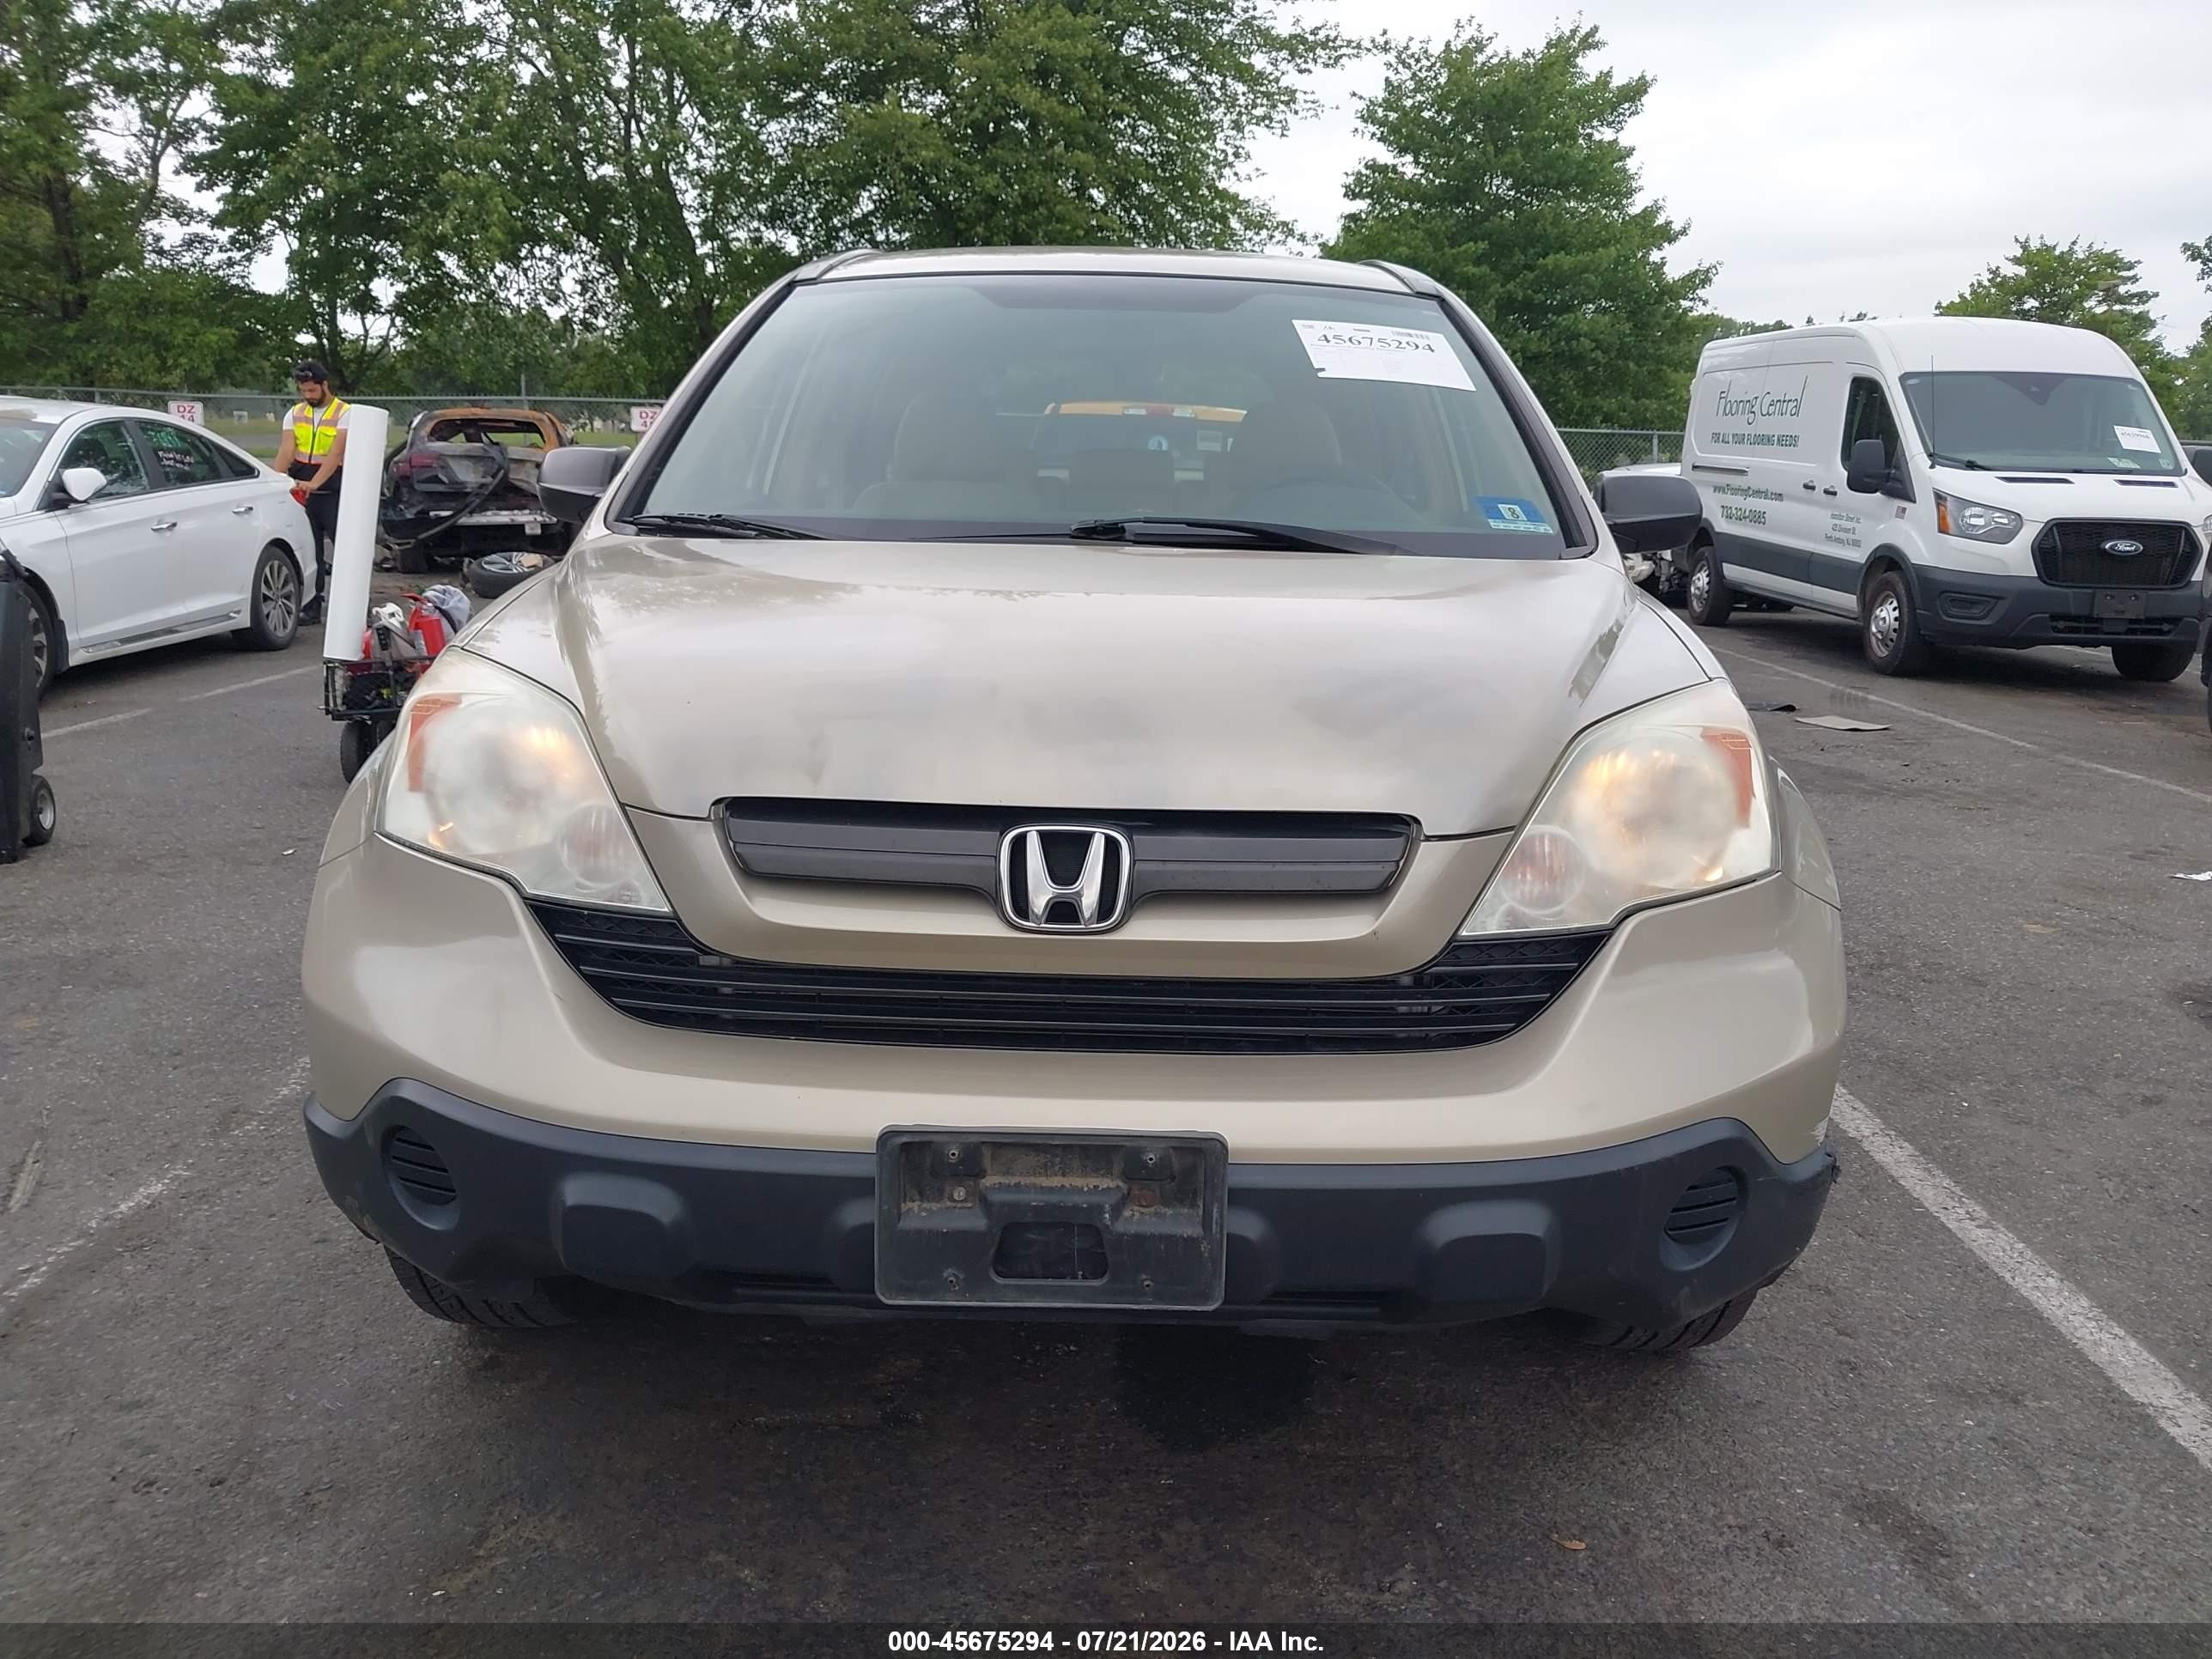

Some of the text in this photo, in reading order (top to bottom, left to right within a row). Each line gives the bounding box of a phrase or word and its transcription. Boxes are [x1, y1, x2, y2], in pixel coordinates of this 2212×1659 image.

[1317, 333, 1435, 353] 45675294
[178, 404, 196, 414] DZ
[1716, 375, 1808, 425] Flooring Central
[1711, 432, 1800, 447] FOR ALL YOUR FLOORING NEEDS!
[1720, 505, 1766, 526] 732-324-0885
